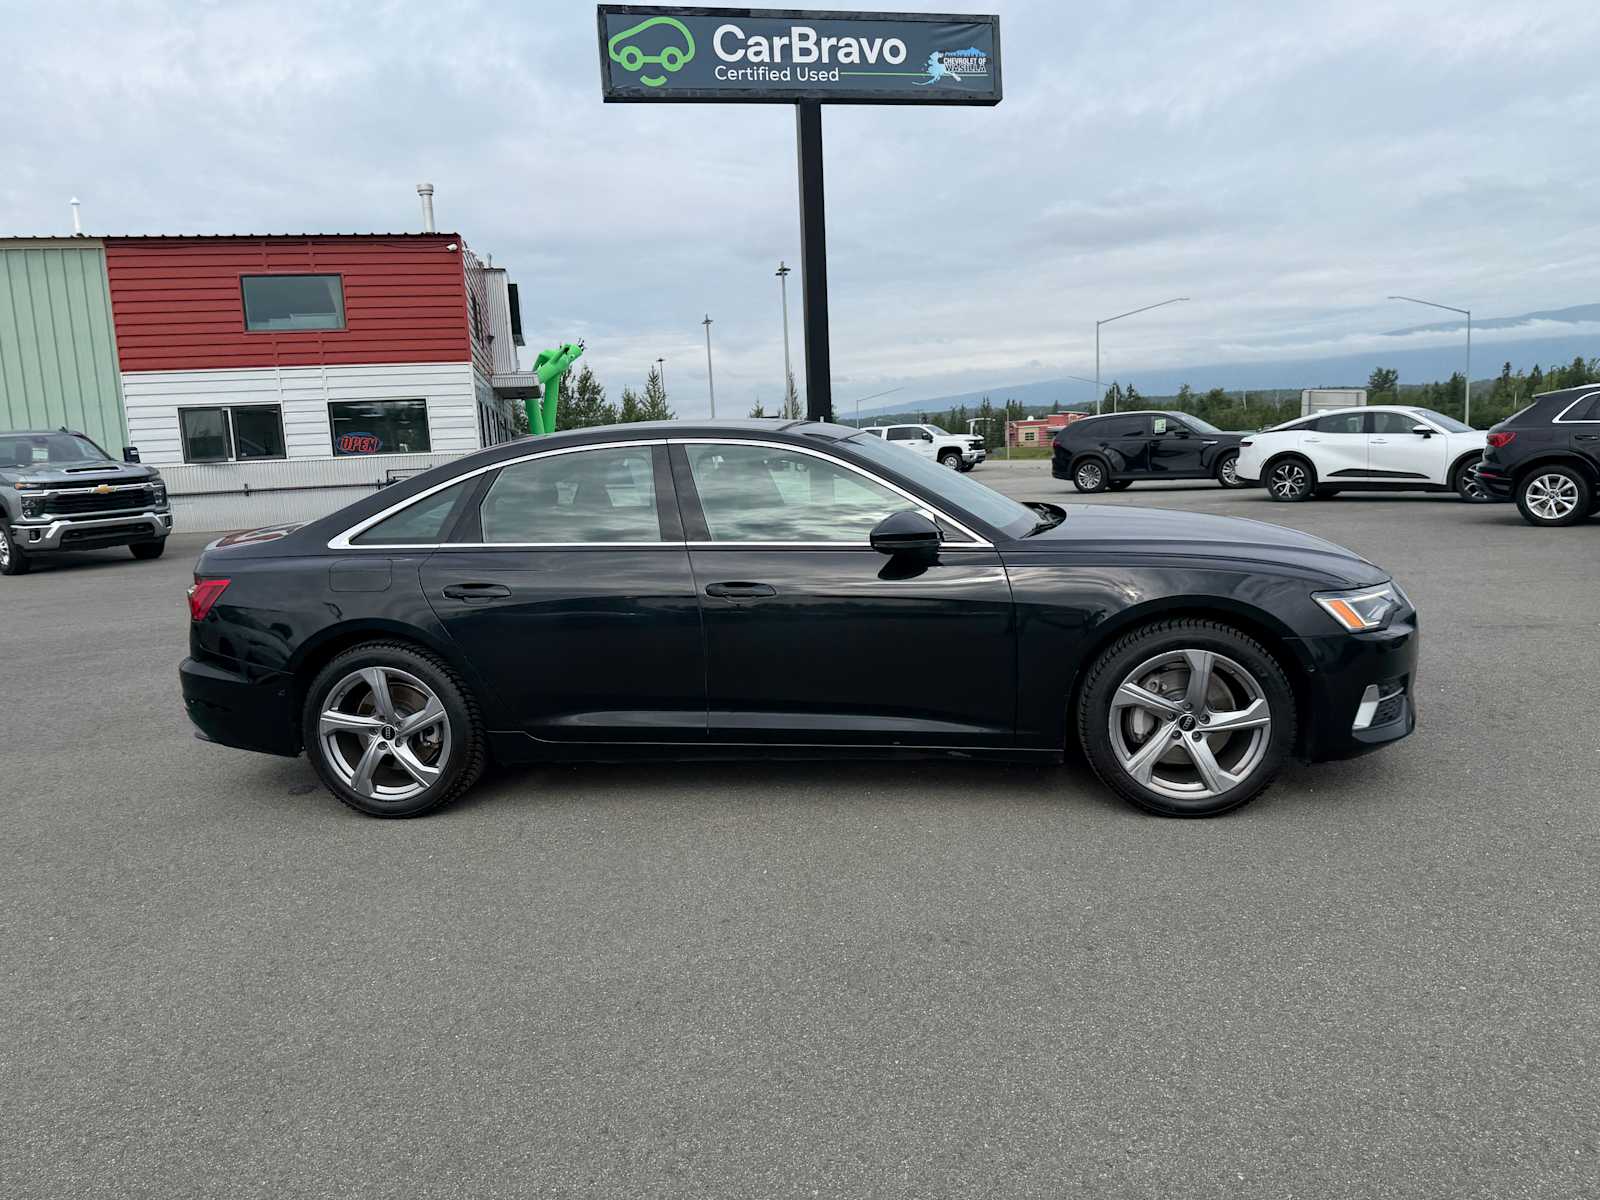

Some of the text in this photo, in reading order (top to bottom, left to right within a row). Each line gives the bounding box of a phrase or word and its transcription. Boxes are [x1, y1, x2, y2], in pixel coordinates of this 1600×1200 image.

[713, 24, 907, 65] CarBravo
[943, 57, 987, 65] CHEVROLET OF
[944, 64, 987, 73] WASILLA
[715, 65, 839, 81] Certified Used
[341, 435, 377, 453] OPEN
